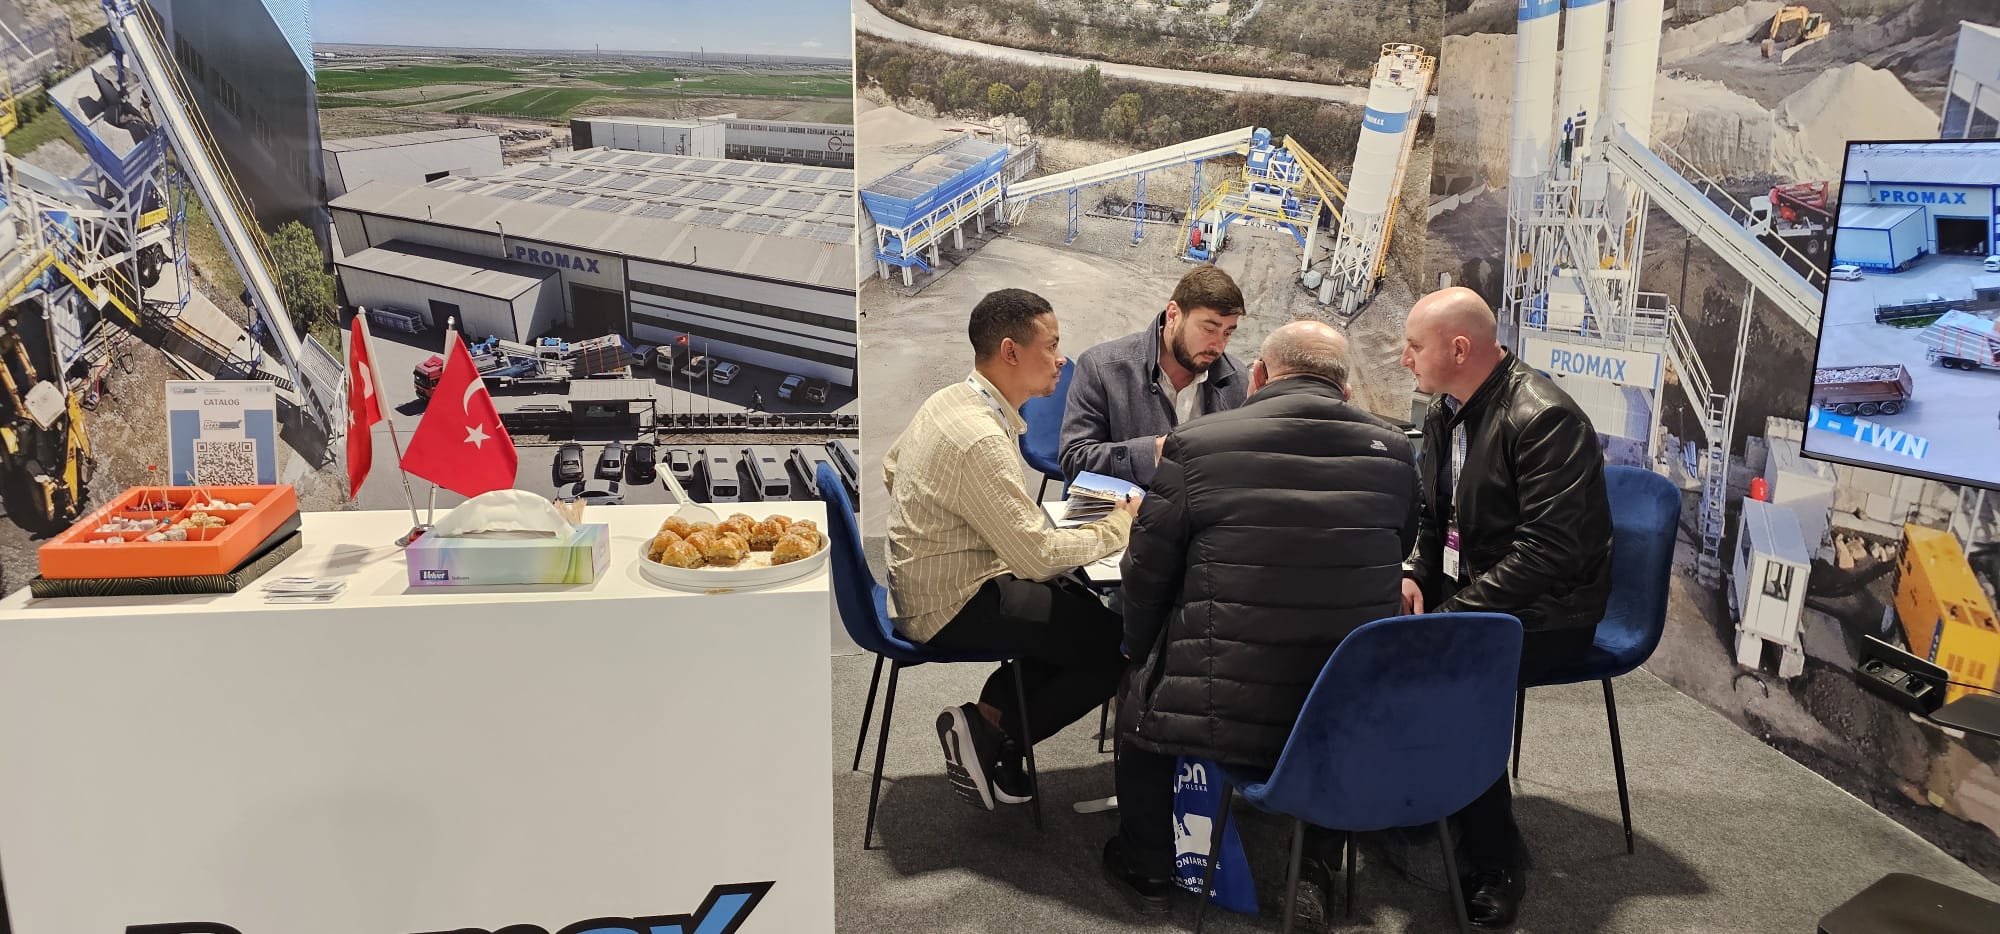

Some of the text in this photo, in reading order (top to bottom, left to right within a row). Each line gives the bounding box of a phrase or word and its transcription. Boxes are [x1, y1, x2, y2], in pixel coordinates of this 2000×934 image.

[1879, 190, 1967, 205] PROMAX
[515, 246, 600, 274] PROMAX
[1550, 348, 1627, 382] PROMAX
[1853, 416, 1928, 460] TWN
